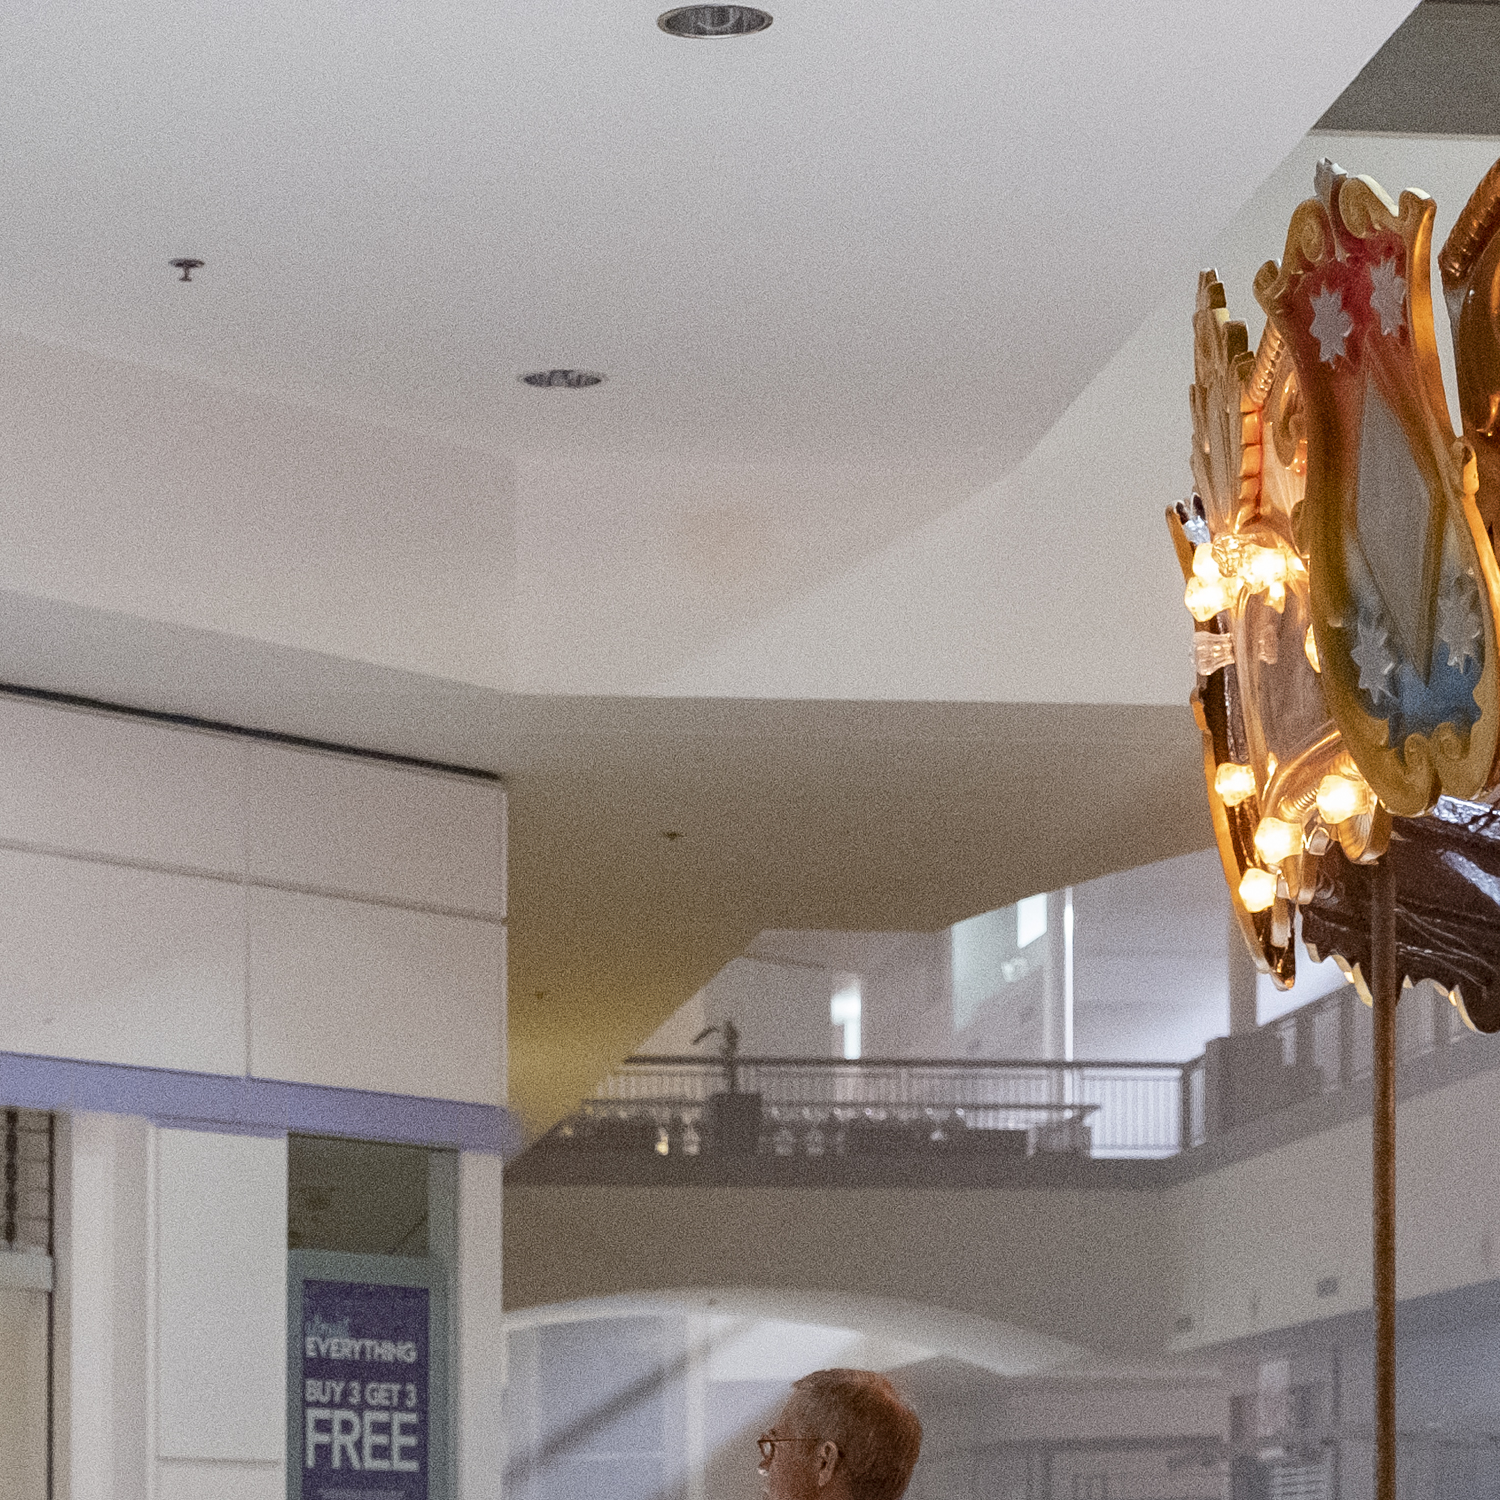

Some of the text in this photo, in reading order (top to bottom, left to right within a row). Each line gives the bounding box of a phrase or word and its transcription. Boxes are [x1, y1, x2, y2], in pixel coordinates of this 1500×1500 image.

[305, 1337, 417, 1364] EVERYTHING
[305, 1379, 417, 1408] BUY 3 GET 3
[306, 1407, 419, 1472] FREE
